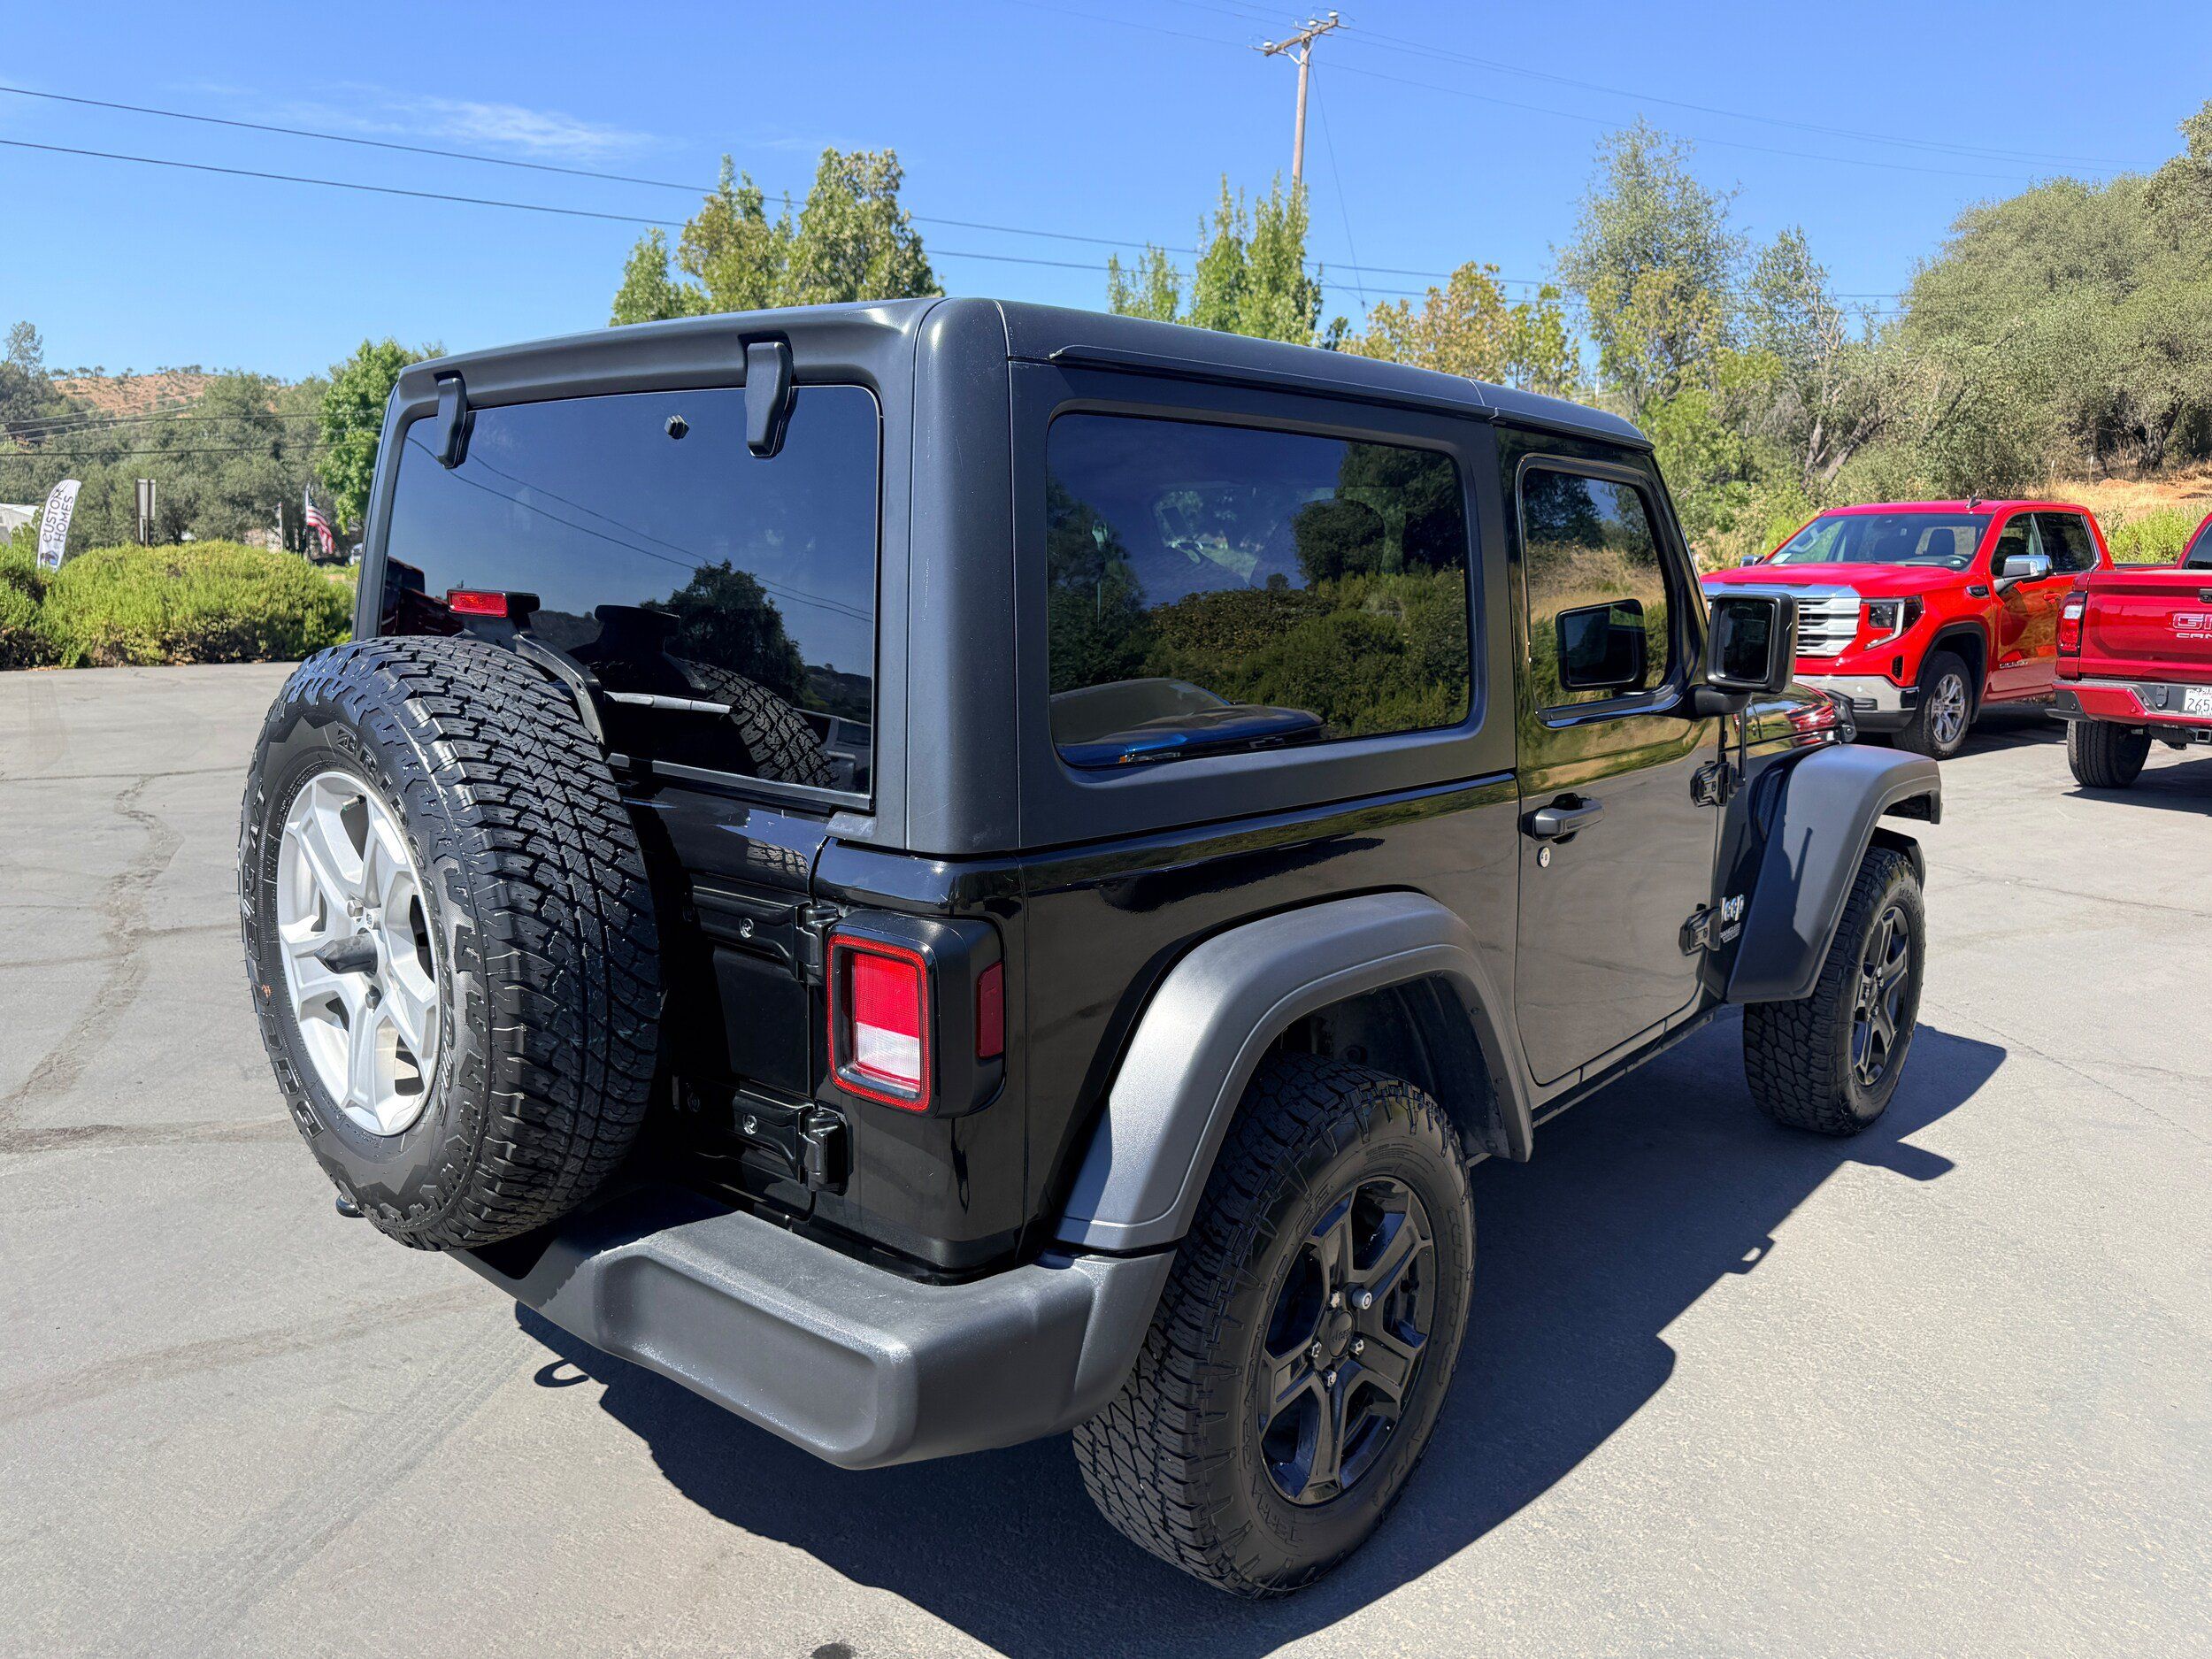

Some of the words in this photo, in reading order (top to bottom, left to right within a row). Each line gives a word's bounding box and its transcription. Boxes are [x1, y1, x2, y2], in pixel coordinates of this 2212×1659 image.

[54, 495, 73, 542] HOMES
[2172, 613, 2212, 630] G
[2187, 698, 2212, 711] 265
[1720, 894, 1744, 924] Jeep
